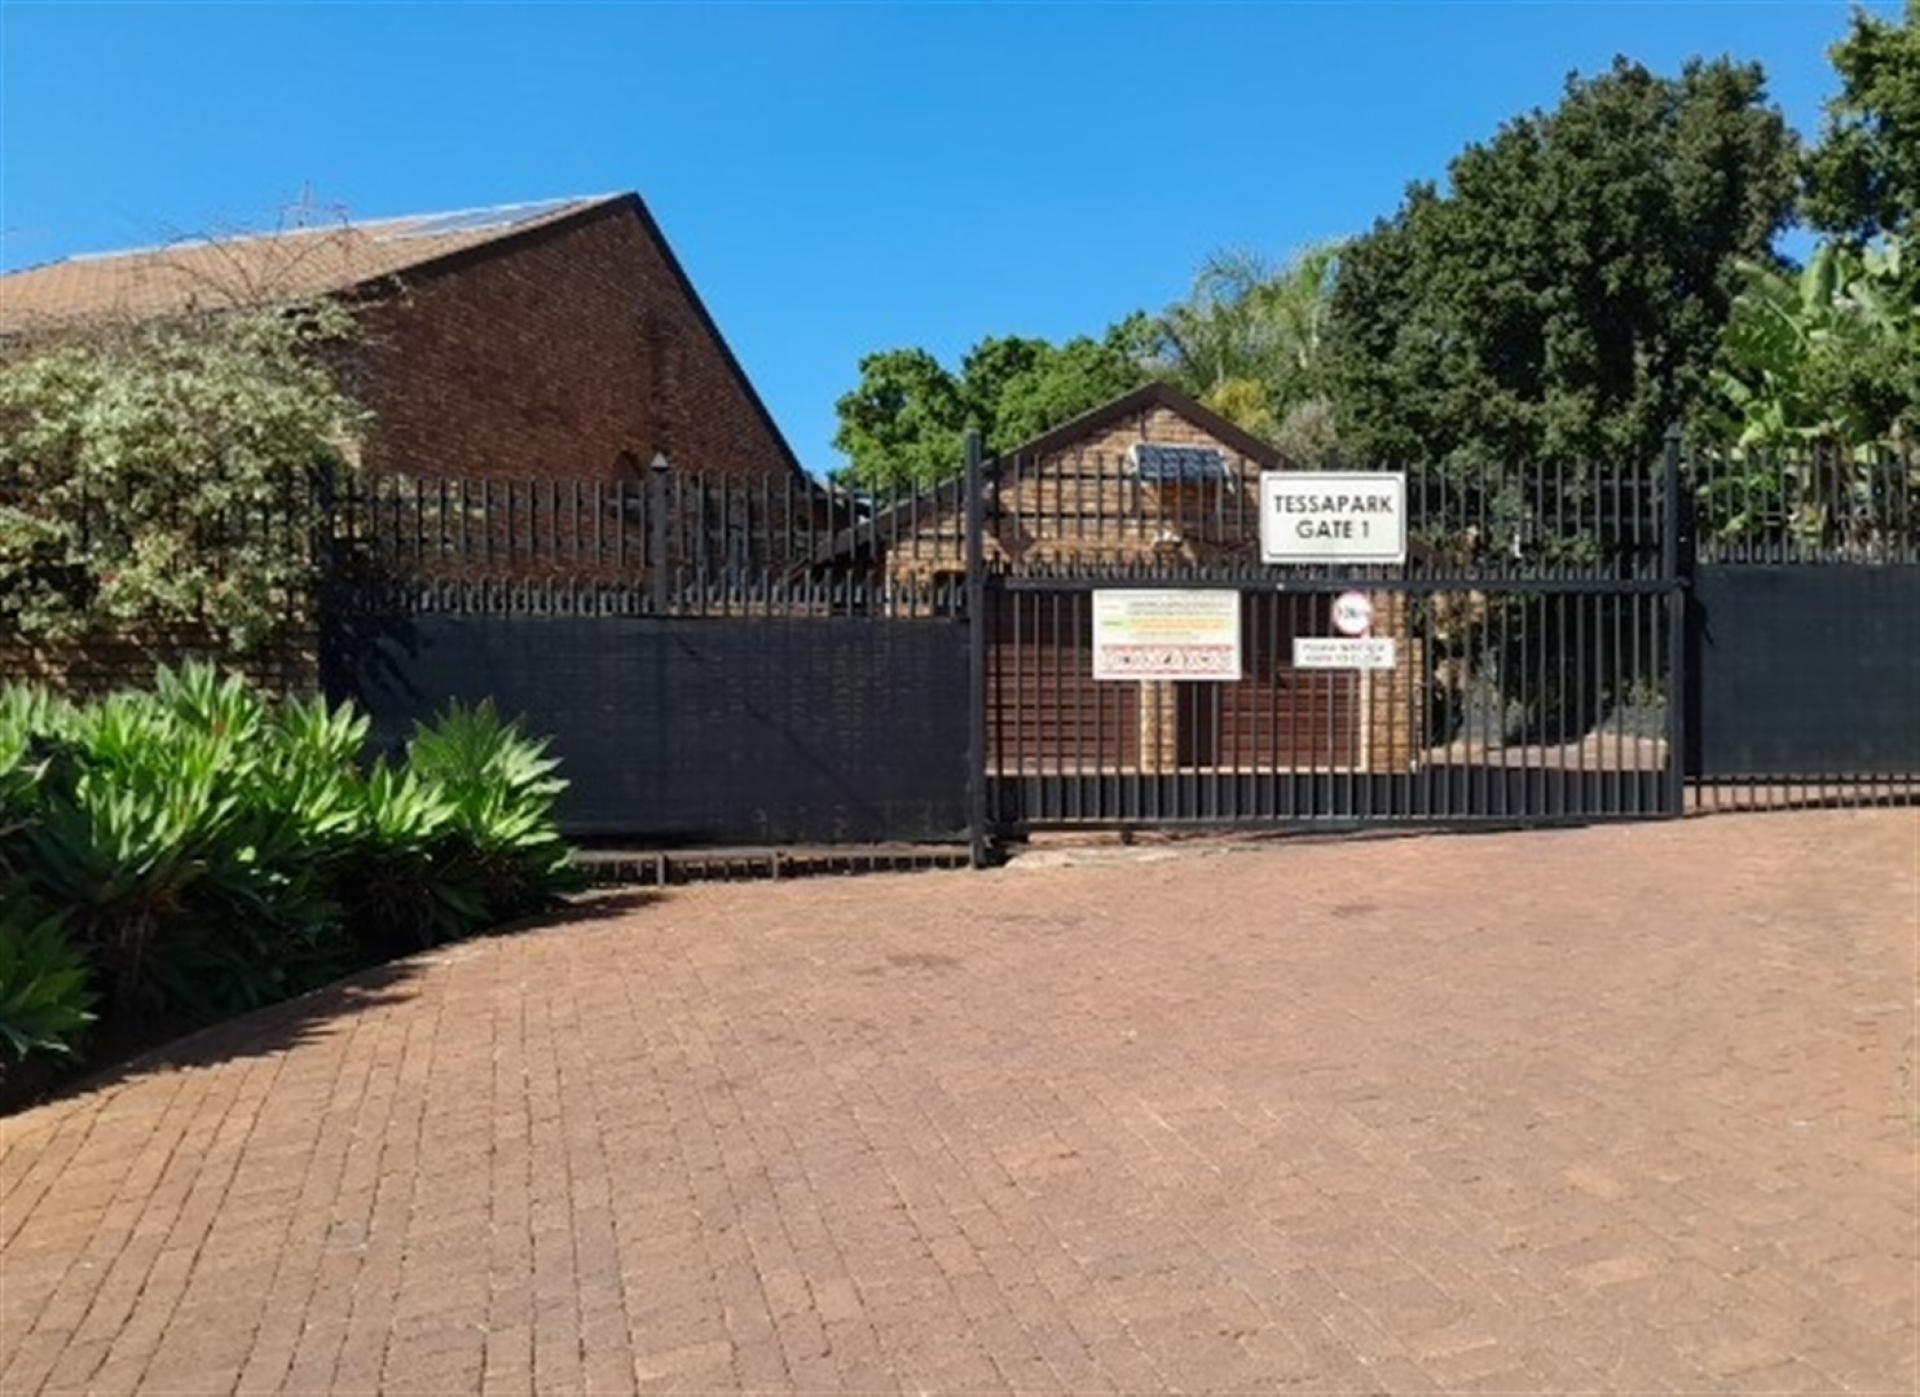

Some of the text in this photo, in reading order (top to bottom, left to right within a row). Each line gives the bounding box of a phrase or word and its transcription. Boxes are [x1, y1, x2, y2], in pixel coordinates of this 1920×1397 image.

[1274, 495, 1392, 513] TESSAPARK
[1296, 520, 1370, 538] GATE 1
